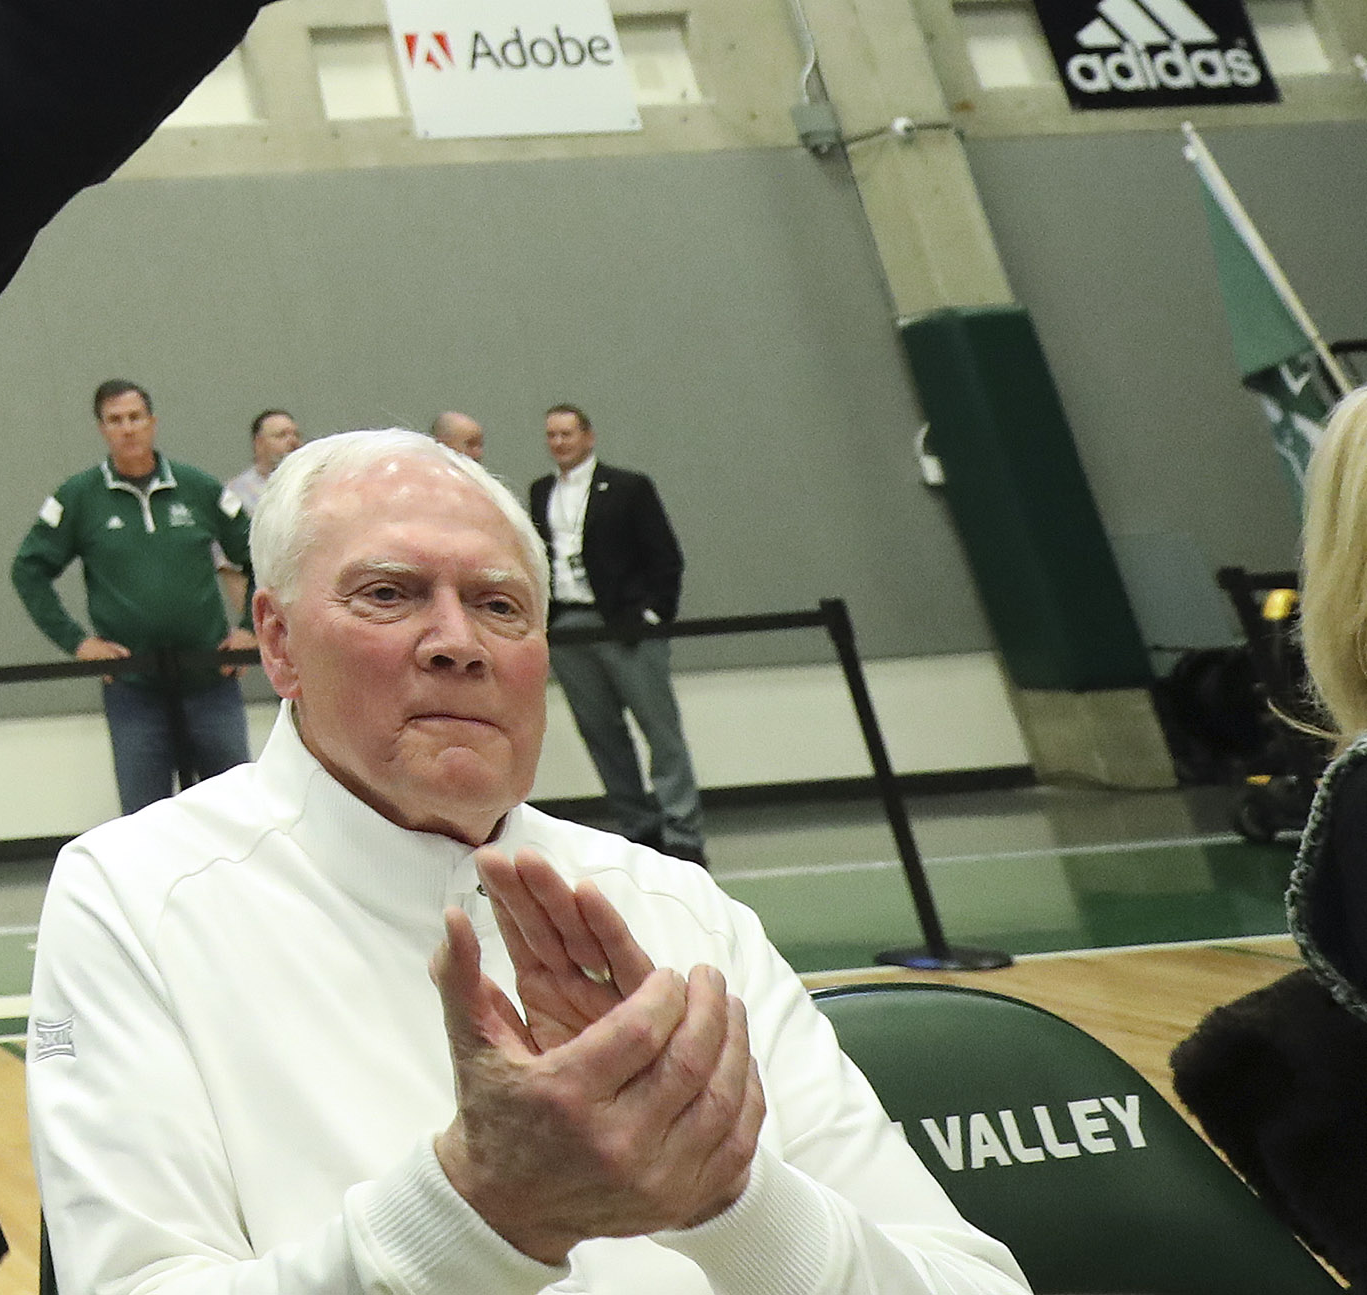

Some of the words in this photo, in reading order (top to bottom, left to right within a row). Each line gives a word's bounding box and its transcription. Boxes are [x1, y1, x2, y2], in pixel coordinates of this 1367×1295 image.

[470, 24, 613, 70] Adobe
[1067, 39, 1261, 93] adidas
[920, 1095, 1148, 1172] VALLEY
